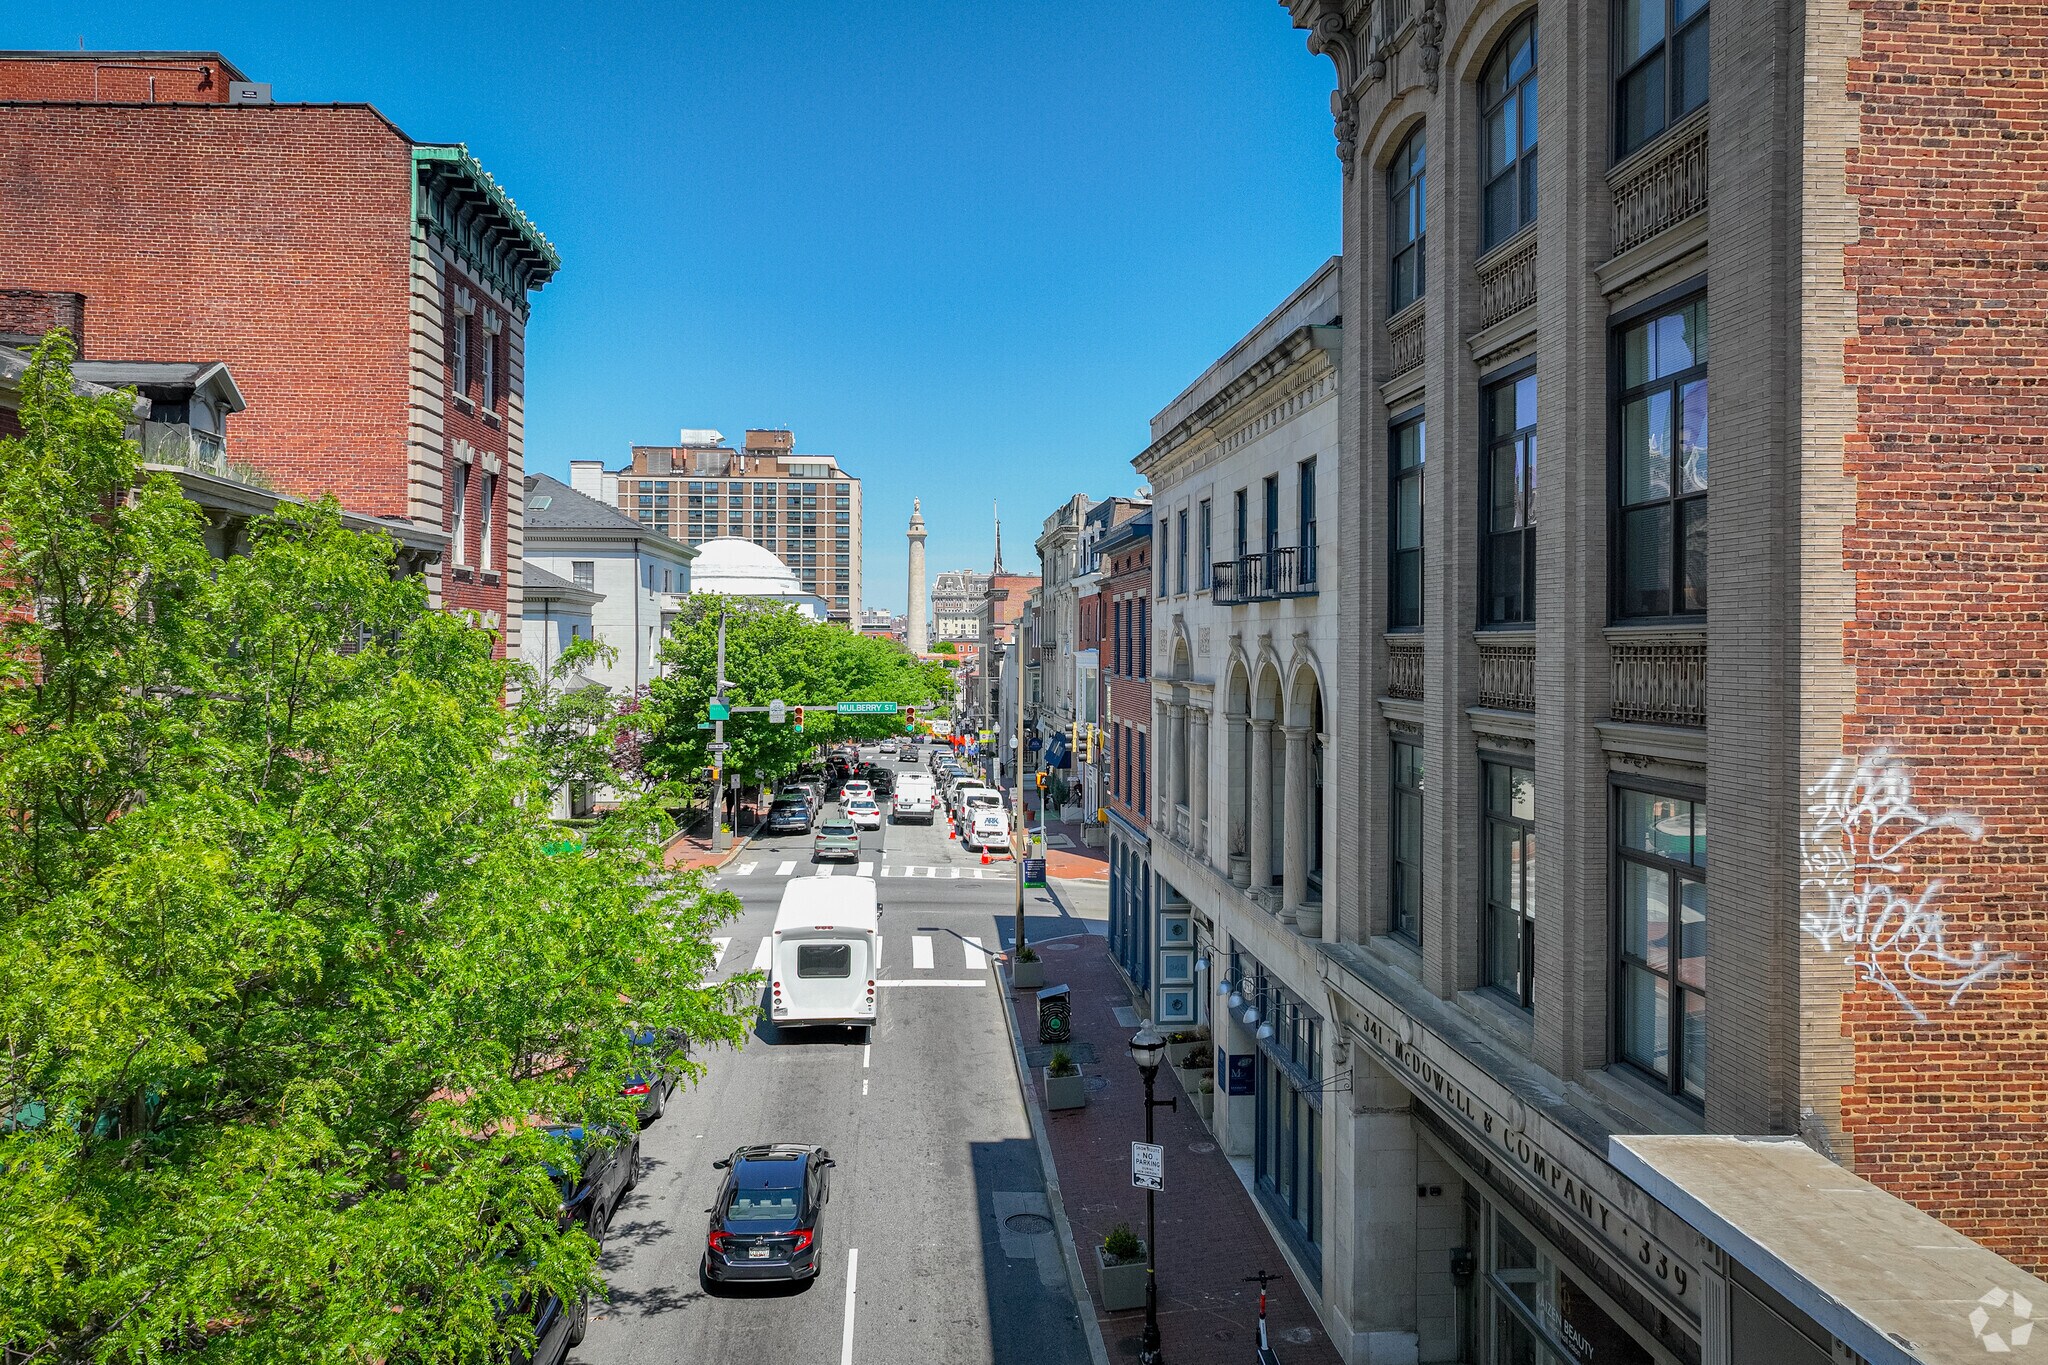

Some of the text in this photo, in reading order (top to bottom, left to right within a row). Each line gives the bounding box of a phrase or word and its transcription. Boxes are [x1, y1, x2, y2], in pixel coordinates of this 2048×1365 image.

[839, 704, 882, 712] MULBERRY
[1142, 1152, 1153, 1160] NO
[1363, 1014, 1687, 1295] 341 McDOWELL & COMPANY 339
[1136, 1158, 1160, 1168] PARKING
[1536, 1292, 1562, 1328] KAIZEN
[1563, 1319, 1594, 1359] BEAUTY
